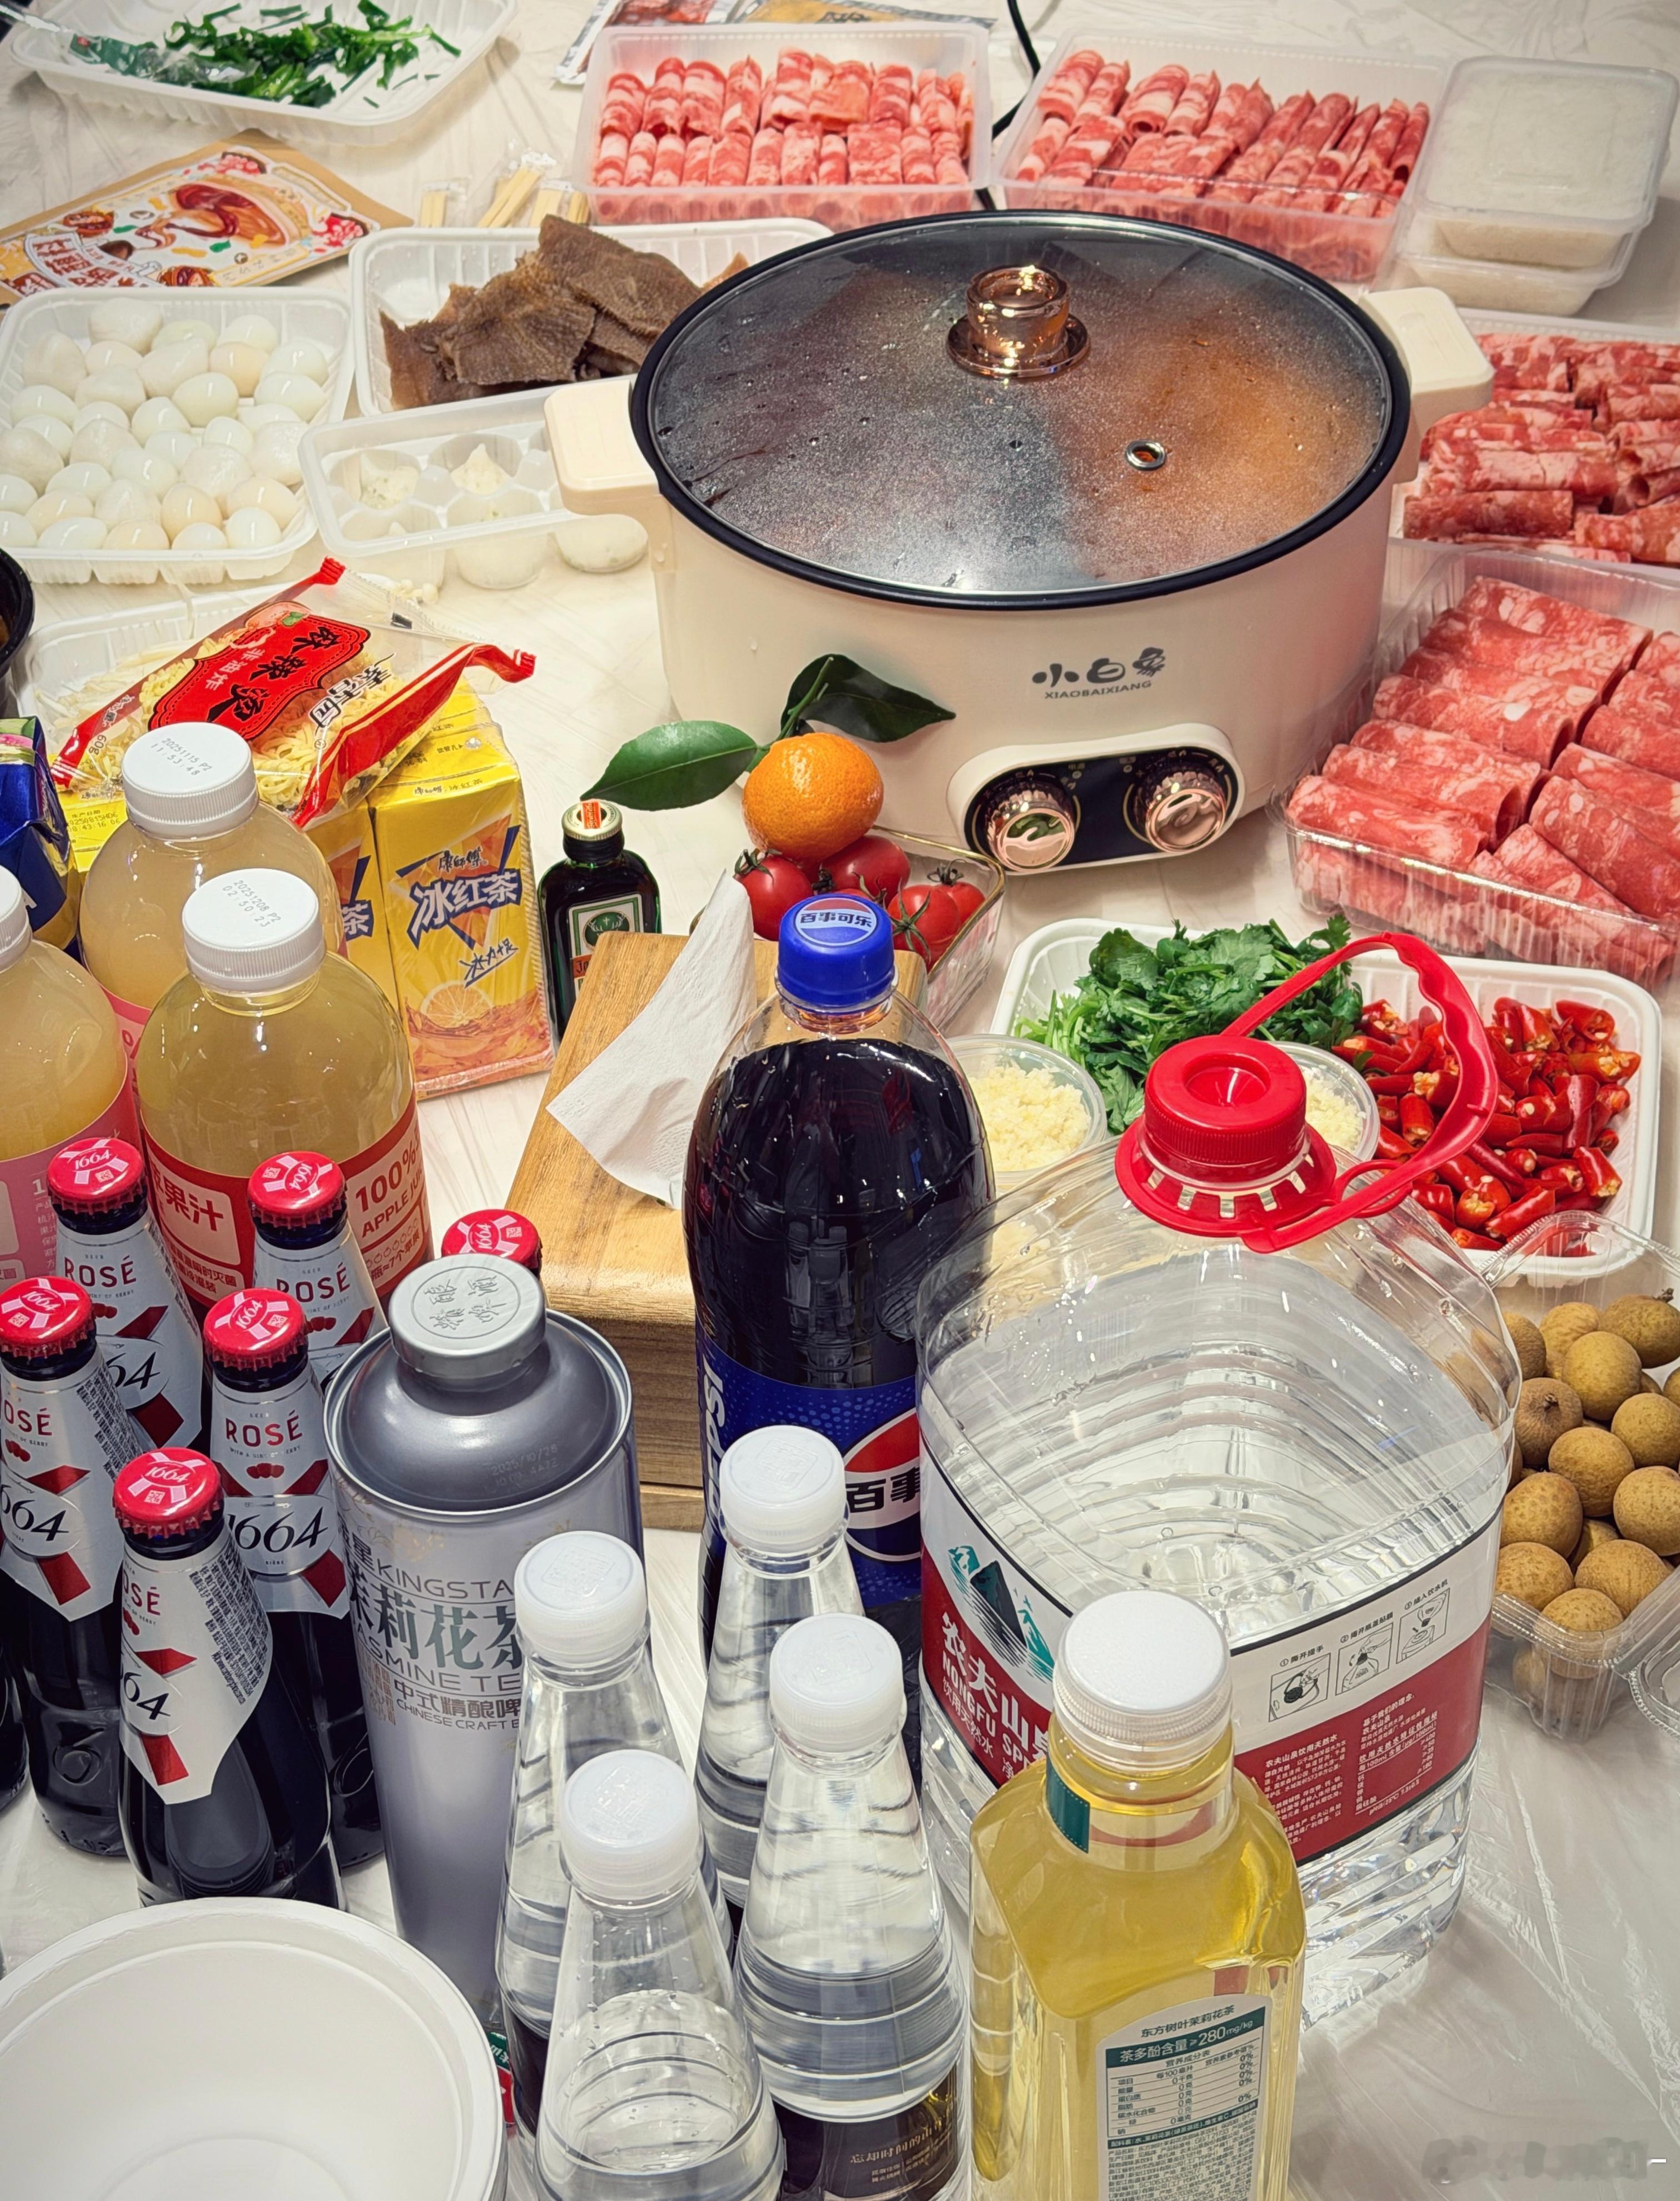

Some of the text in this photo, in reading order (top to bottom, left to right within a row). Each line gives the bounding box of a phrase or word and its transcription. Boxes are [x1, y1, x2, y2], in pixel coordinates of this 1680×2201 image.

[206, 648, 266, 691] 非油炸
[1044, 680, 1152, 699] XIAOBAIXIANG
[438, 846, 483, 872] 康师傅
[222, 885, 271, 927] 02:50:23
[233, 879, 282, 923] 20251208 P2
[410, 870, 520, 941] 冰红茶
[800, 911, 872, 928] 百事可乐
[74, 1148, 113, 1170] 1664
[289, 1162, 313, 1190] 1664
[362, 1190, 408, 1238] APPLE
[475, 1222, 493, 1250] 1664
[64, 1254, 137, 1288] ROSÉ
[23, 1289, 62, 1313] 1664
[236, 1299, 264, 1330] 1664
[4, 1399, 52, 1437] OSÉ
[226, 1409, 303, 1447] ROSÉ
[146, 1464, 191, 1484] 1664
[846, 1465, 921, 1514] 百事
[0, 1484, 69, 1542] 664
[227, 1506, 329, 1553] 1664
[377, 1558, 514, 1600] KINGSTA
[394, 1678, 522, 1719] 中式精酿啤
[470, 1672, 522, 1693] TE
[942, 1649, 996, 1738] NONGFU
[396, 1699, 453, 1727] CHINESE
[455, 1718, 508, 1731] CRAFT
[942, 1675, 994, 1759] 饮用天然水
[1141, 2004, 1235, 2038] 东方树叶茉莉花茶
[1166, 2049, 1212, 2067] 营养成分表
